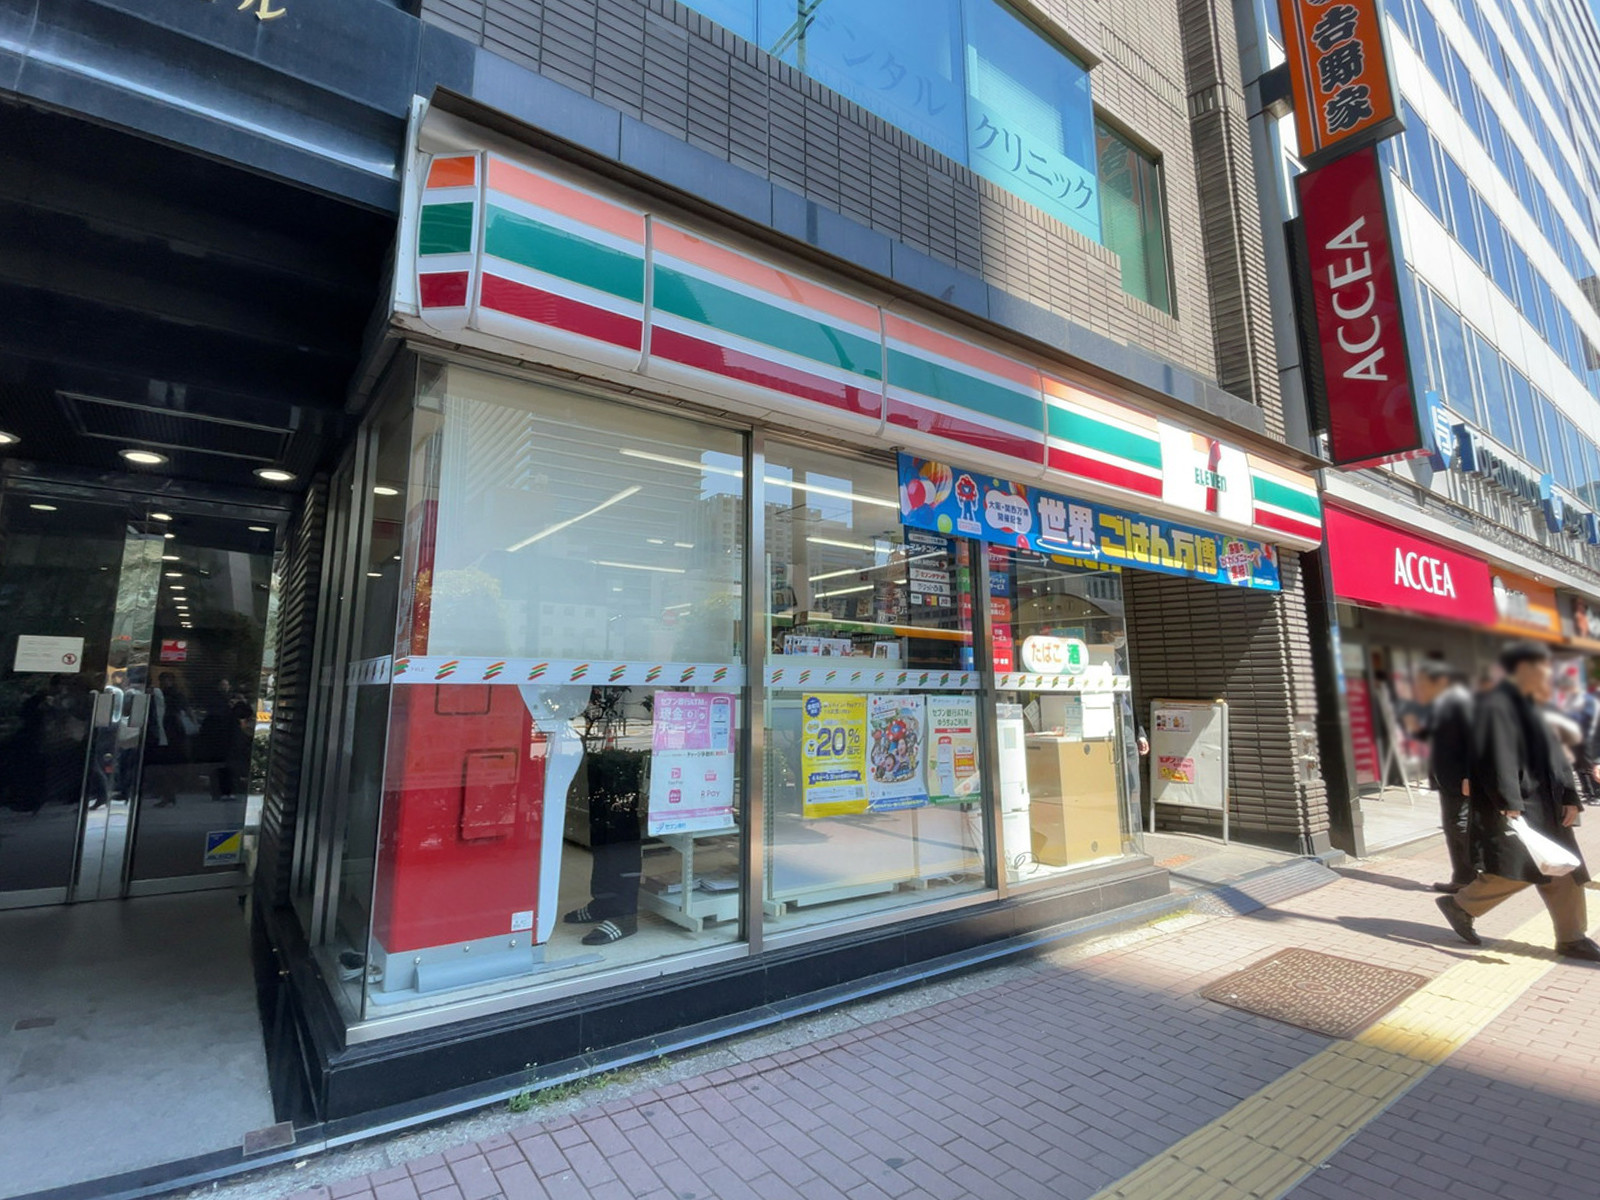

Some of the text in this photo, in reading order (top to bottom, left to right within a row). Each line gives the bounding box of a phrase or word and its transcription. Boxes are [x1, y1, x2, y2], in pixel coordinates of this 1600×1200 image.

[1311, 4, 1375, 135] 吉野家
[974, 114, 1094, 210] クリニック
[1324, 214, 1389, 382] ACCEA
[1394, 546, 1457, 599] ACCEA
[1031, 642, 1081, 665] たばこ 酒
